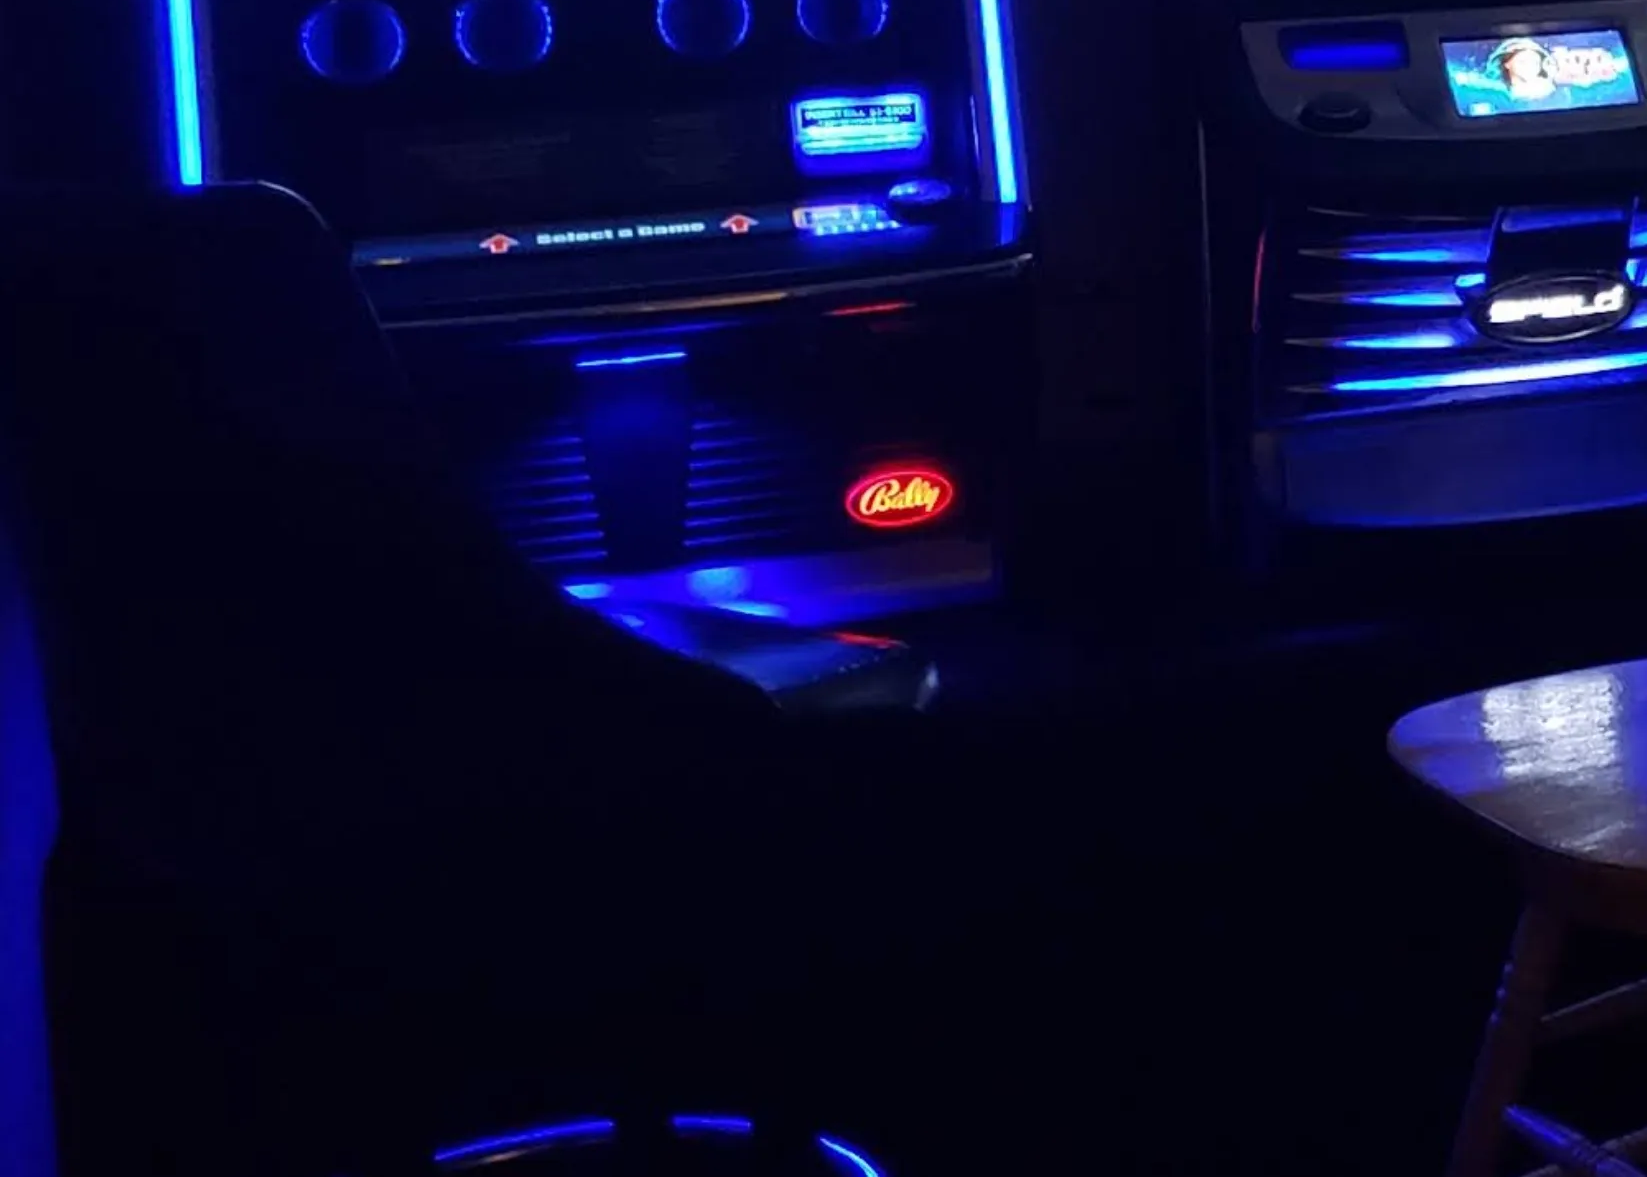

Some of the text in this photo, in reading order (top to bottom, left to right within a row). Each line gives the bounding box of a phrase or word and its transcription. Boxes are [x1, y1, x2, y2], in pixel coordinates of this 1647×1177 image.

[536, 227, 614, 246] Select
[638, 221, 705, 236] Game
[859, 476, 941, 515] Bally
